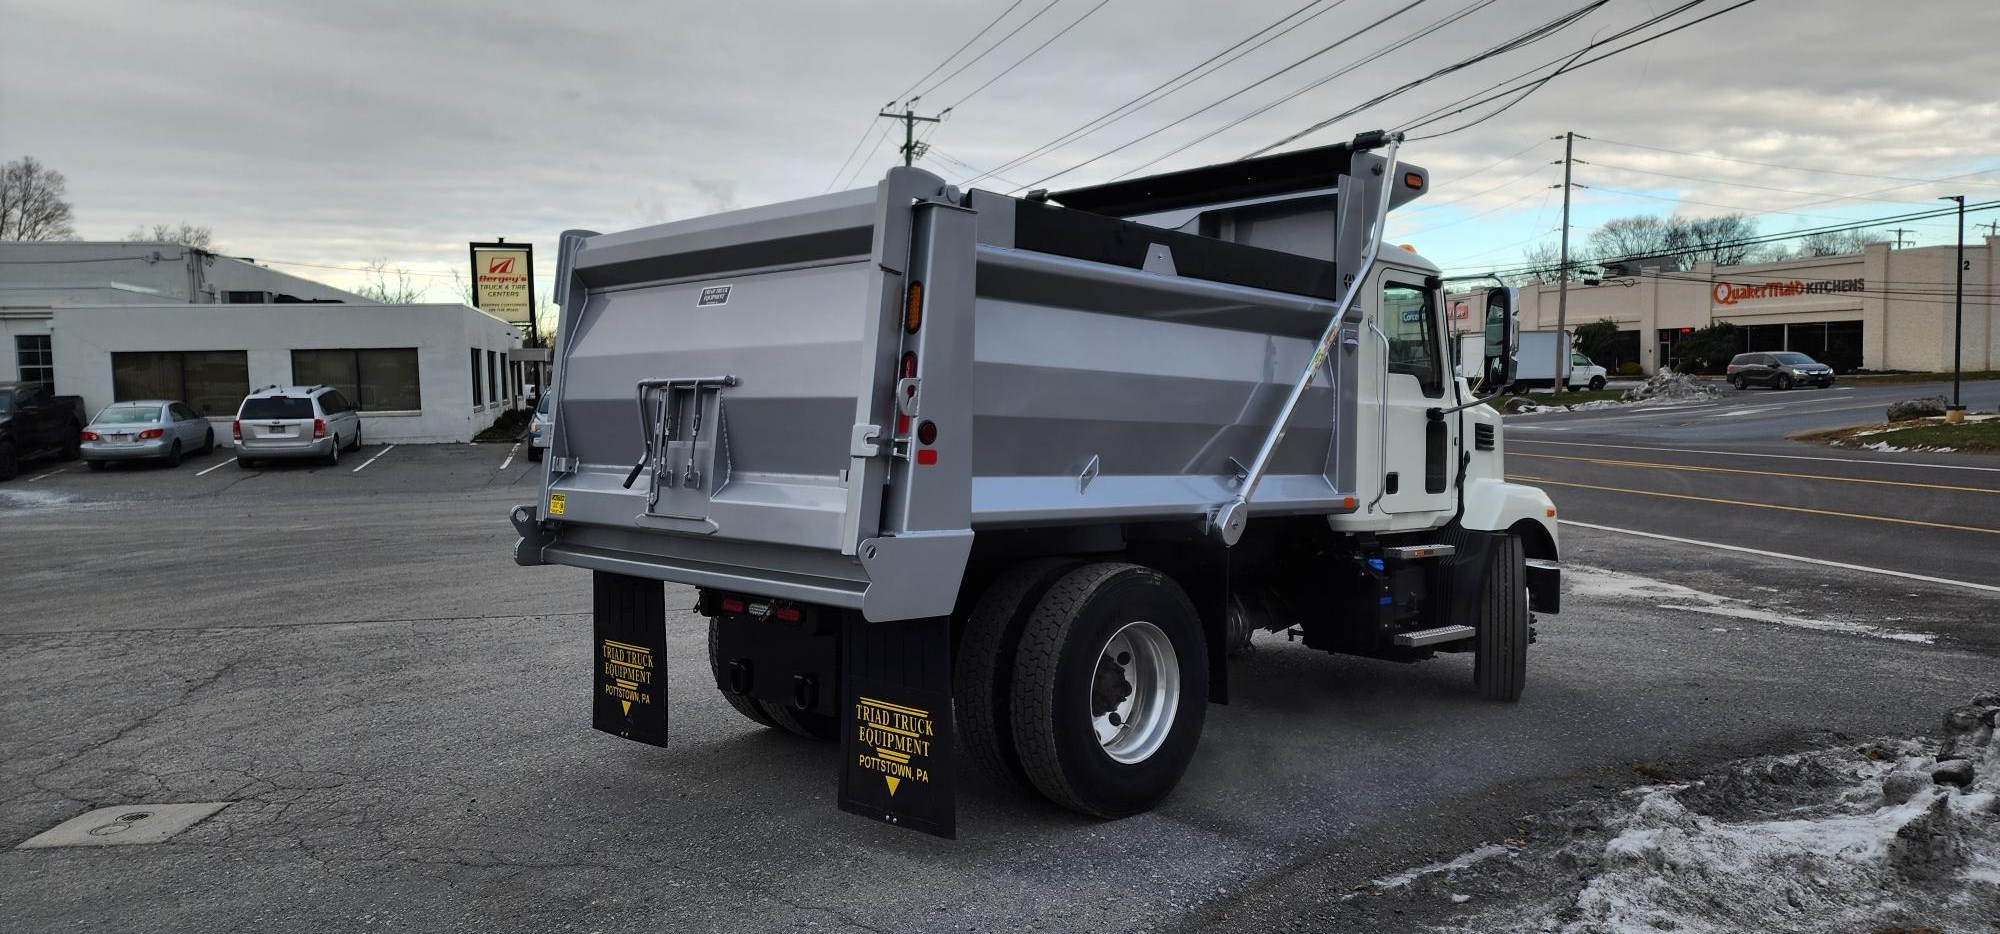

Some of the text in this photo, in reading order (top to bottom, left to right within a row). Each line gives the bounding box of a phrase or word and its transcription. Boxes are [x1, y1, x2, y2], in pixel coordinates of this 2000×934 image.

[1963, 260, 1970, 270] 2
[479, 275, 527, 283] Bergey's
[1805, 278, 1865, 294] KITCHENS
[602, 645, 654, 668] TRIAD TRUCK
[604, 662, 652, 684] EQUIPMENT
[605, 684, 651, 705] POTTSTOWN, PA
[856, 704, 934, 736] TRIAD TRUCK
[858, 726, 931, 757] EQUIPMENT
[859, 754, 929, 783] POTTSTOWN, PA
